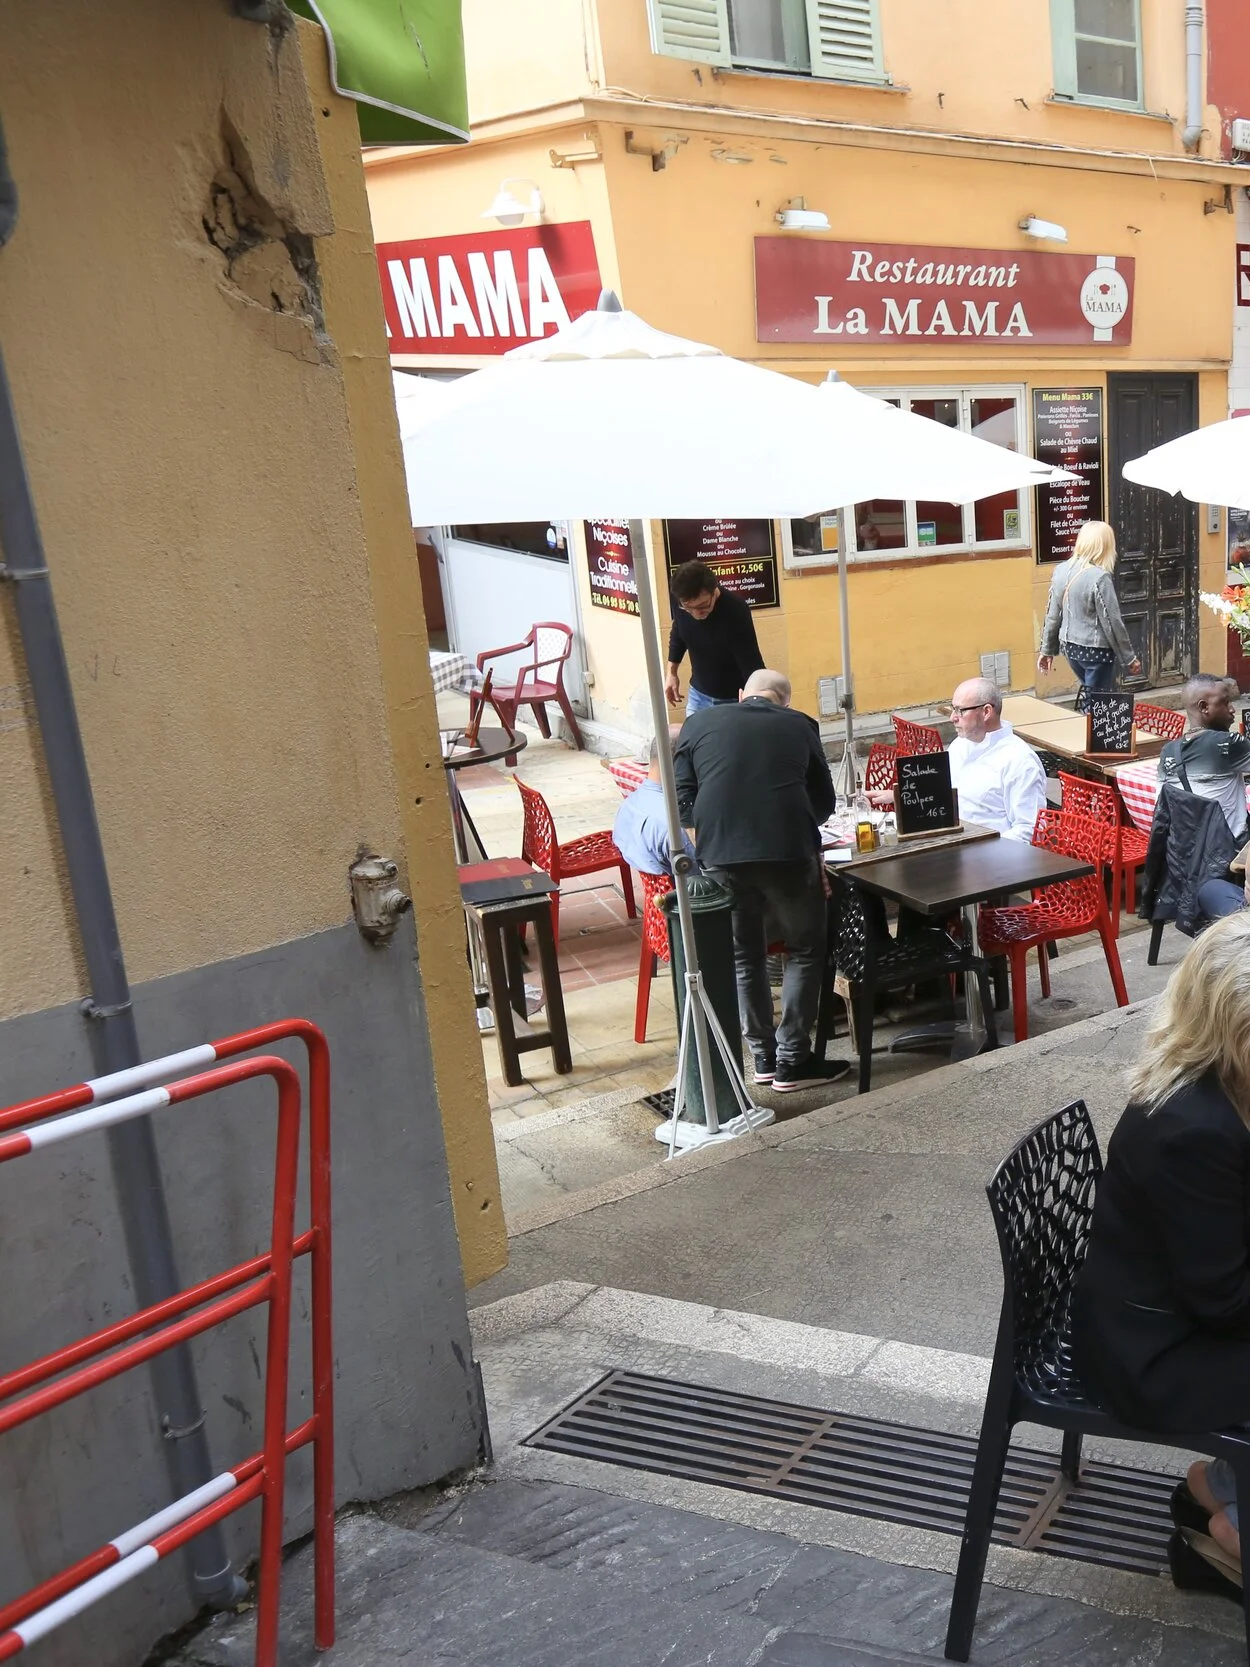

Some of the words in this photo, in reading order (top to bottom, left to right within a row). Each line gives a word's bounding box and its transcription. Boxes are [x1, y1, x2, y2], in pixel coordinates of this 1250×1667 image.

[846, 250, 1021, 288] Restaurant
[387, 247, 573, 338] MAMA
[1085, 301, 1123, 313] MAMA
[813, 295, 869, 335] La
[880, 298, 1033, 337] MAMA
[1042, 394, 1061, 402] Menu
[1062, 393, 1081, 401] Mama
[1081, 392, 1094, 400] 33€
[1049, 406, 1069, 414] Assiette
[1069, 405, 1087, 413] Niçoise
[1040, 438, 1057, 447] Salade
[1057, 438, 1064, 446] de
[1064, 437, 1081, 446] Chèvre
[1081, 436, 1098, 445] Chaud
[1067, 445, 1079, 453] Miel
[1063, 463, 1078, 471] Boeuf
[1082, 461, 1099, 470] Ravioli
[1049, 480, 1071, 489] Escalope
[1078, 479, 1090, 487] Veau
[1049, 496, 1063, 504] Pièce
[1062, 495, 1070, 504] du
[1069, 494, 1090, 503] Boucher
[702, 524, 720, 532] Crème
[719, 522, 737, 531] Brûlée
[1050, 520, 1061, 529] Filet
[1061, 520, 1068, 528] de
[592, 526, 629, 547] Niçoises
[1055, 528, 1070, 536] Sauce
[702, 537, 719, 545] Dame
[718, 535, 739, 543] Blanche
[724, 547, 747, 556] Chocolat
[1051, 545, 1071, 554] Dessert
[597, 556, 630, 577] Cuisine
[709, 565, 735, 576] nfant
[736, 562, 764, 574] 12,50€
[719, 579, 735, 587] Sauce
[741, 576, 756, 584] choix
[901, 763, 939, 779] Salade
[901, 780, 917, 791] de
